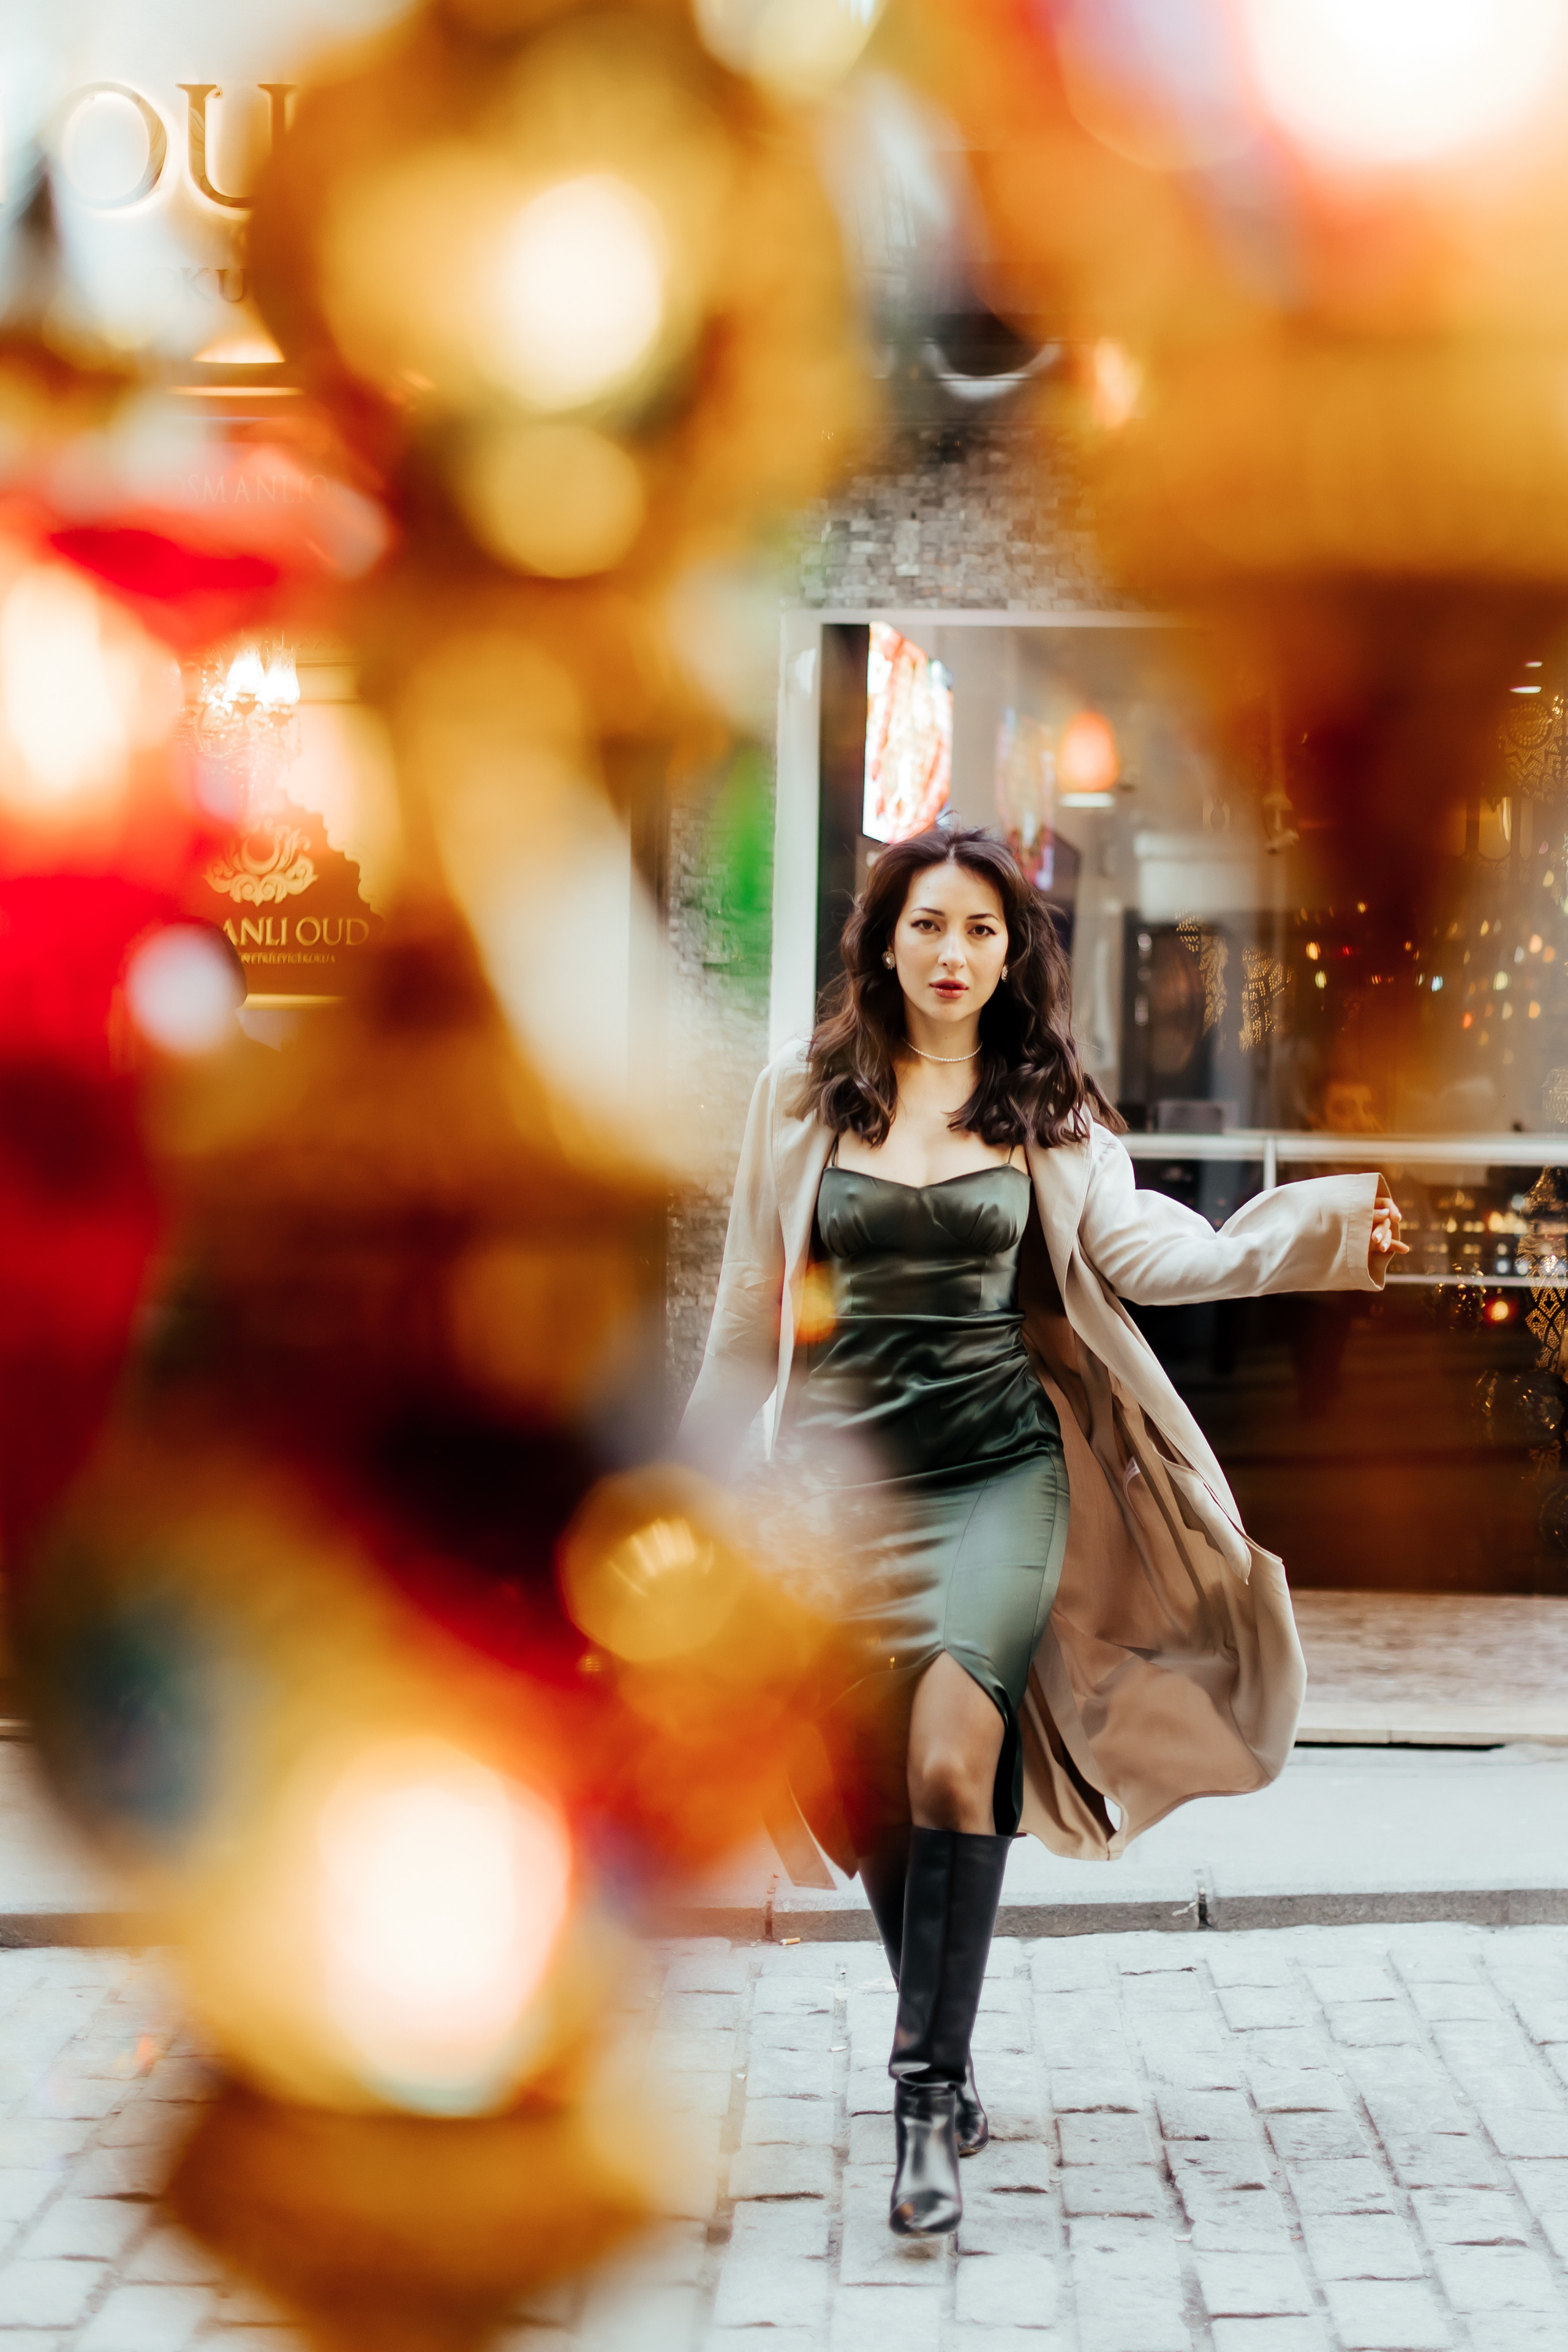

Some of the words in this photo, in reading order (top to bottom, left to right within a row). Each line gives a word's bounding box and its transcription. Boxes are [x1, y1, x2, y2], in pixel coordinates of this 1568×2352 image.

[51, 81, 299, 210] OU
[223, 916, 288, 946] ANLI
[295, 916, 369, 946] OUD
